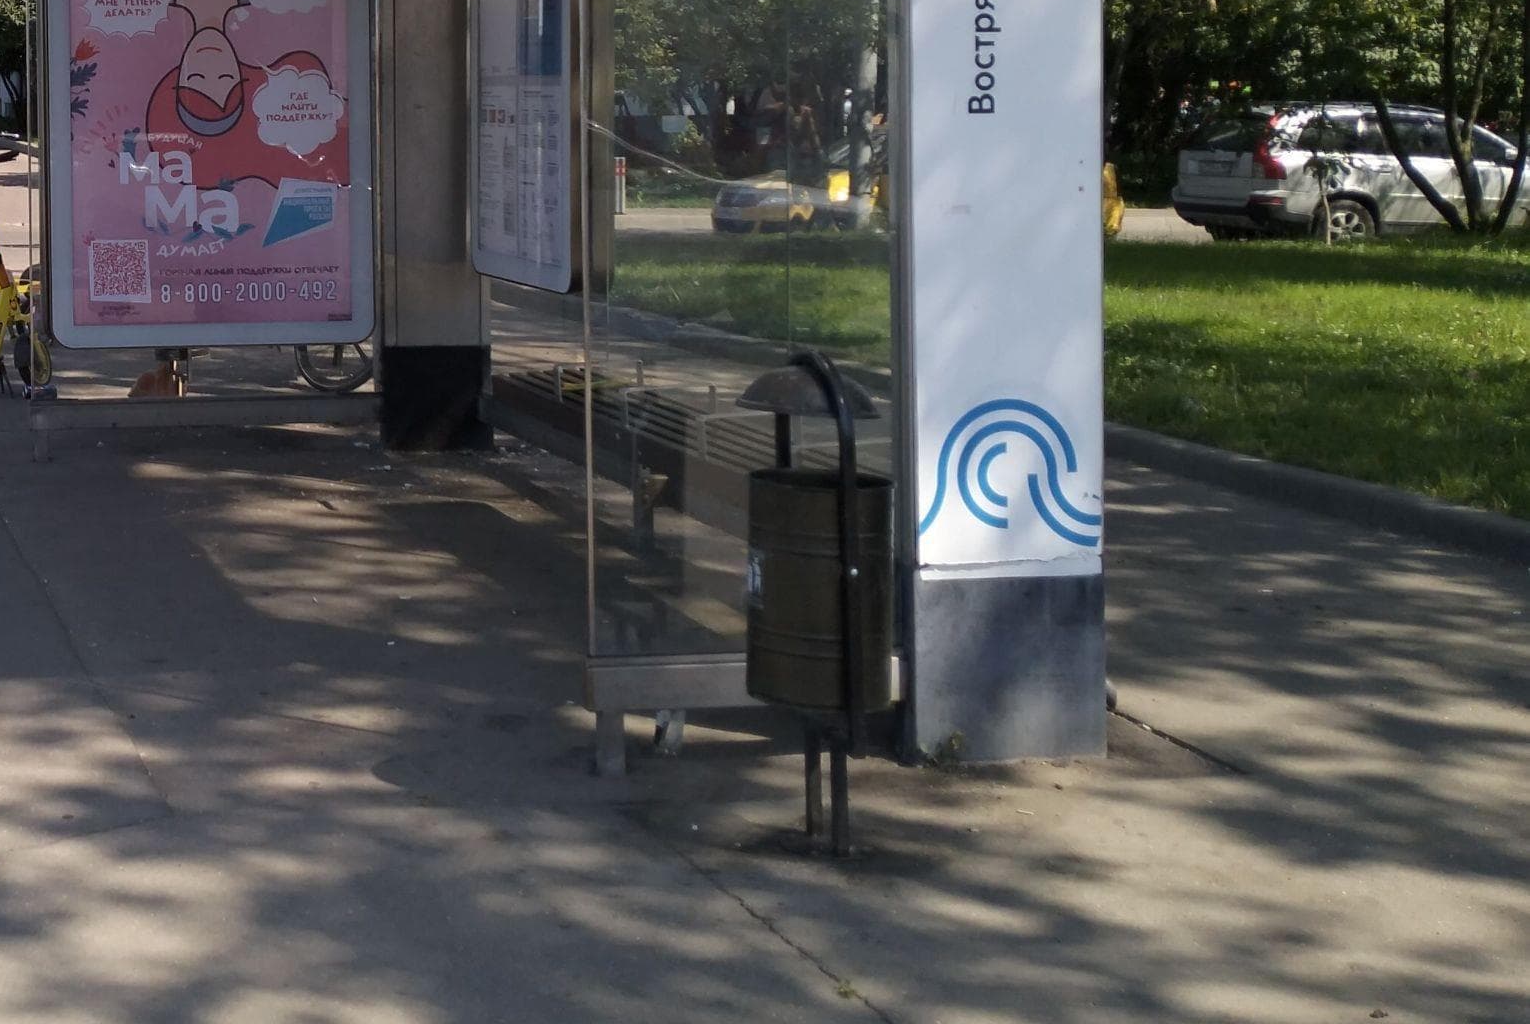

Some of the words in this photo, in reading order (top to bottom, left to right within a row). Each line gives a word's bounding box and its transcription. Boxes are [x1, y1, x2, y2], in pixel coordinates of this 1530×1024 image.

[104, 8, 152, 18] ДЕЛАТЬ?
[289, 91, 309, 101] ГДЕ
[156, 238, 225, 257] ДУМАЕТ
[160, 280, 337, 303] 8-800-2000-492
